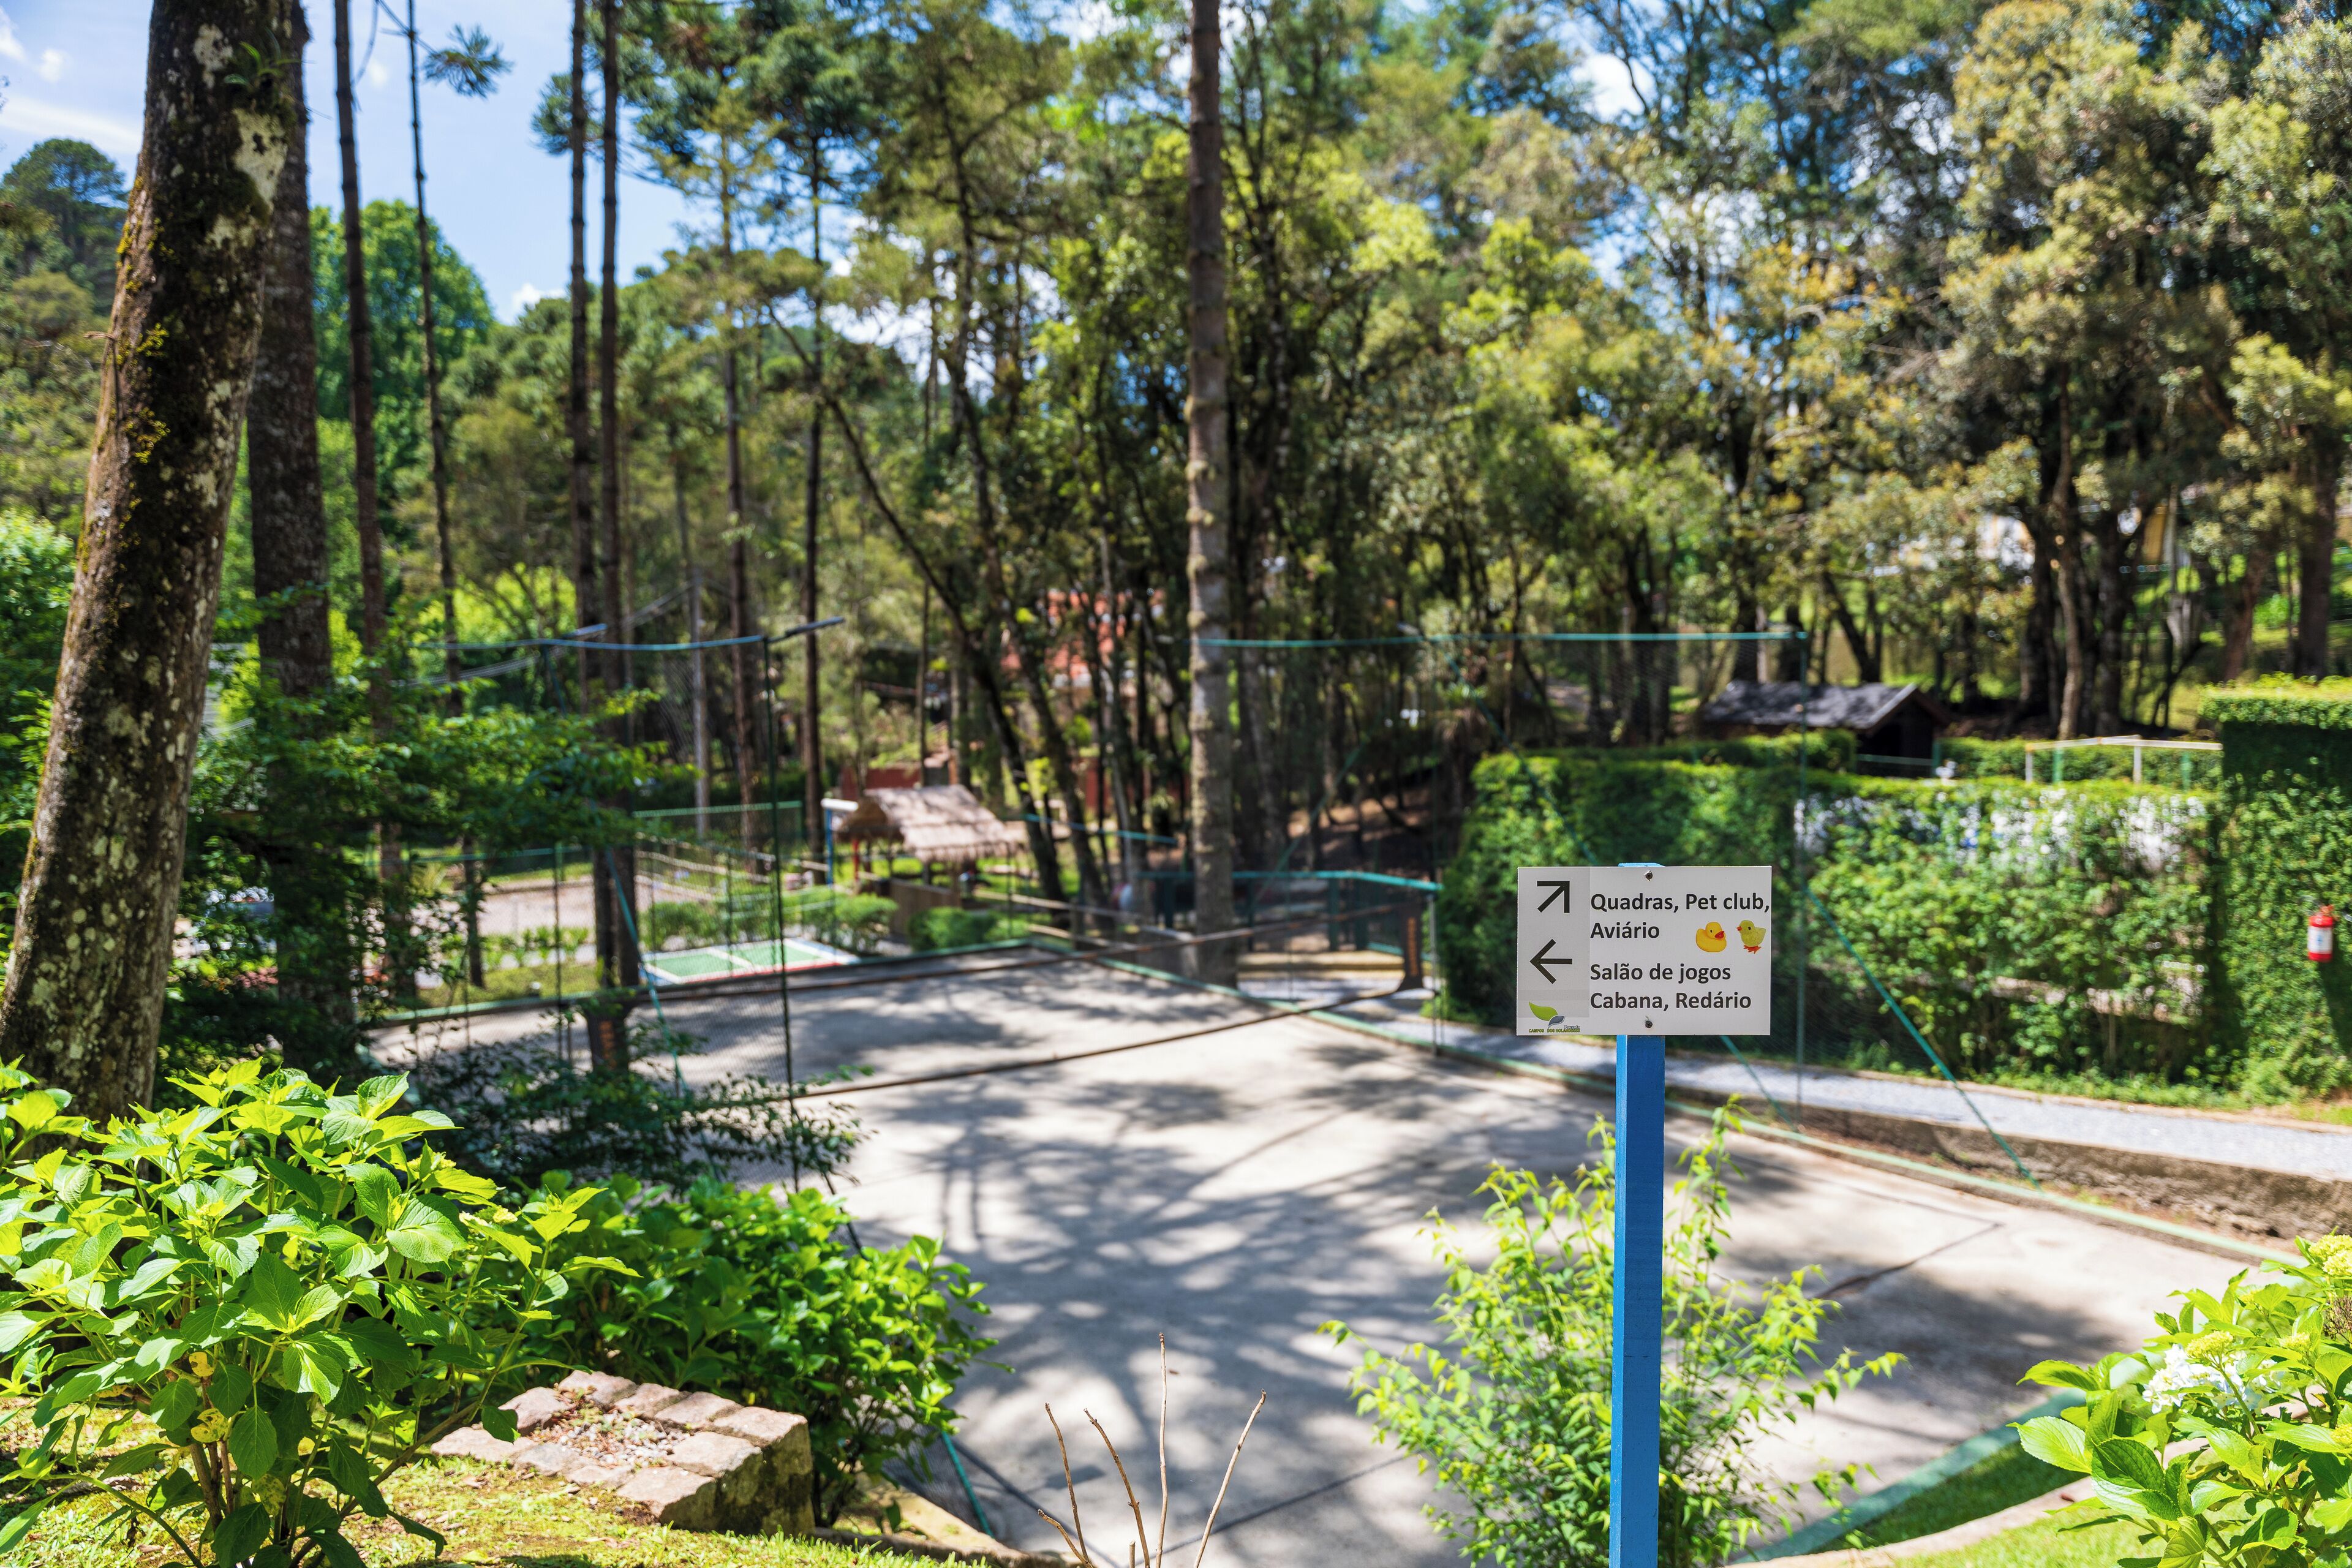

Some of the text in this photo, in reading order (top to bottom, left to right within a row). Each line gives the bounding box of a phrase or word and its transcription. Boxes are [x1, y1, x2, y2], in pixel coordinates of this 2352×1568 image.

[1591, 892, 1770, 913] Quadras, Pet club,
[1590, 921, 1660, 939] Aviário
[1590, 962, 1731, 984] Salão de jogos
[1590, 991, 1752, 1012] Cabana, Redário
